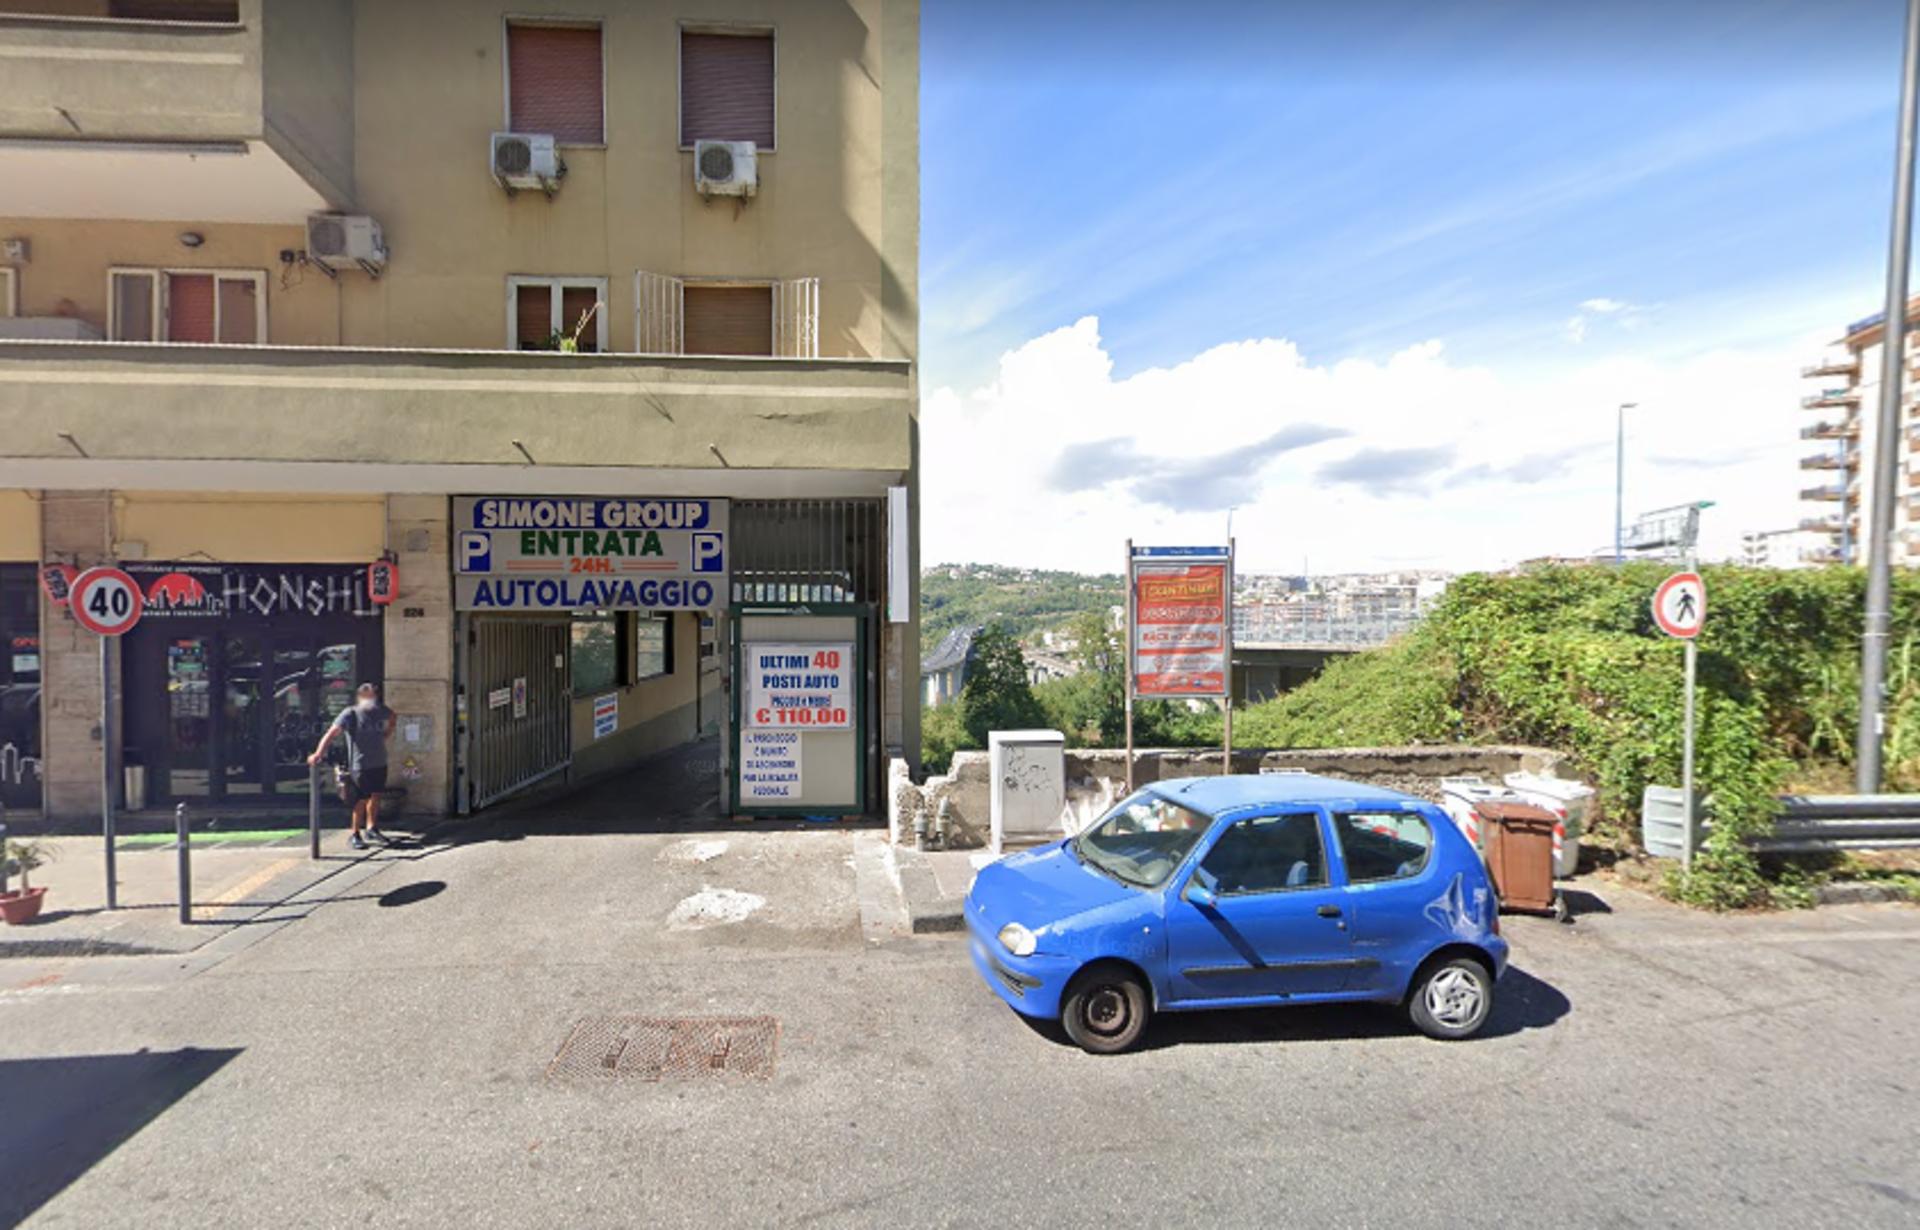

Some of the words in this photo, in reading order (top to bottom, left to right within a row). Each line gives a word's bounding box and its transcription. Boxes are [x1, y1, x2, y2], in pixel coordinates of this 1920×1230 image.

[481, 500, 595, 527] SIMONE
[602, 500, 702, 527] GROUP
[460, 533, 489, 570] P
[520, 531, 663, 556] ENTRATA
[693, 534, 721, 570] P
[89, 586, 129, 617] 40
[473, 580, 714, 606] AUTOLAVAGGIO
[760, 655, 809, 669] ULTIMI
[813, 650, 840, 669] 40
[762, 674, 801, 688] POSTI
[804, 674, 839, 688] AUTO
[755, 708, 770, 724] €
[776, 708, 846, 724] 110.00
